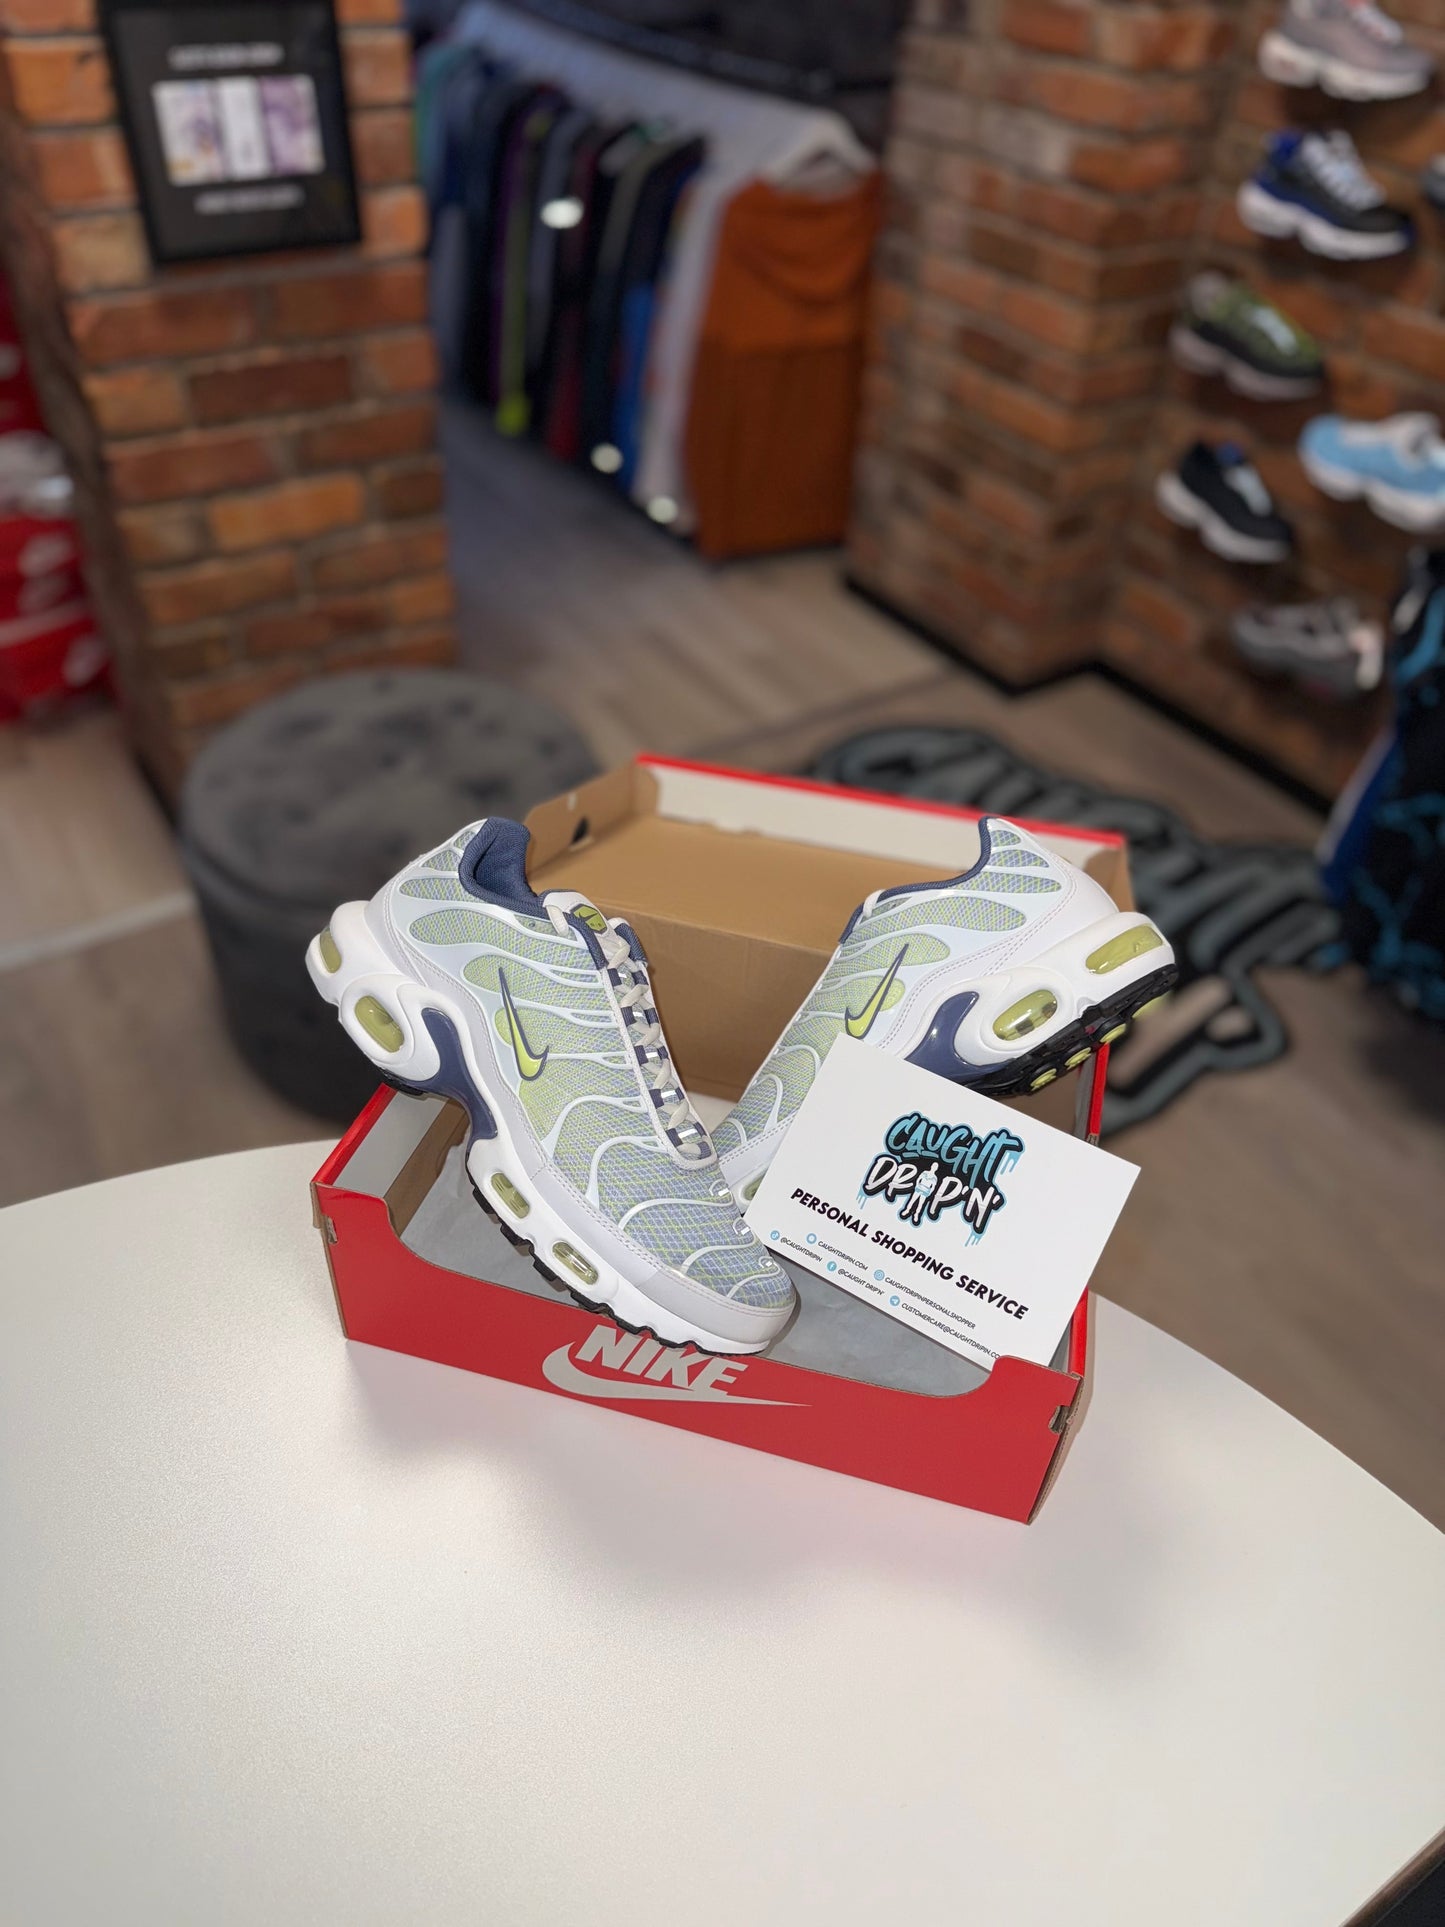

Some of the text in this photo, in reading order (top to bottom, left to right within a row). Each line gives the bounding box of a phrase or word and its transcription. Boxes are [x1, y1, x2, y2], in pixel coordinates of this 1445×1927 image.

[887, 1114, 1021, 1188] CAUGHT
[780, 1237, 823, 1263] @CAUGHTDRIPIN
[790, 1187, 1029, 1320] PERSONAL SHOPPING SERVICE
[818, 1240, 869, 1271] CAUGHTDRIPIN.COM
[837, 1268, 866, 1286] @CAUGHT
[884, 1276, 977, 1330] CAUGHTDRIPINPERSONALSHOPPER
[574, 1323, 749, 1398] NIKE
